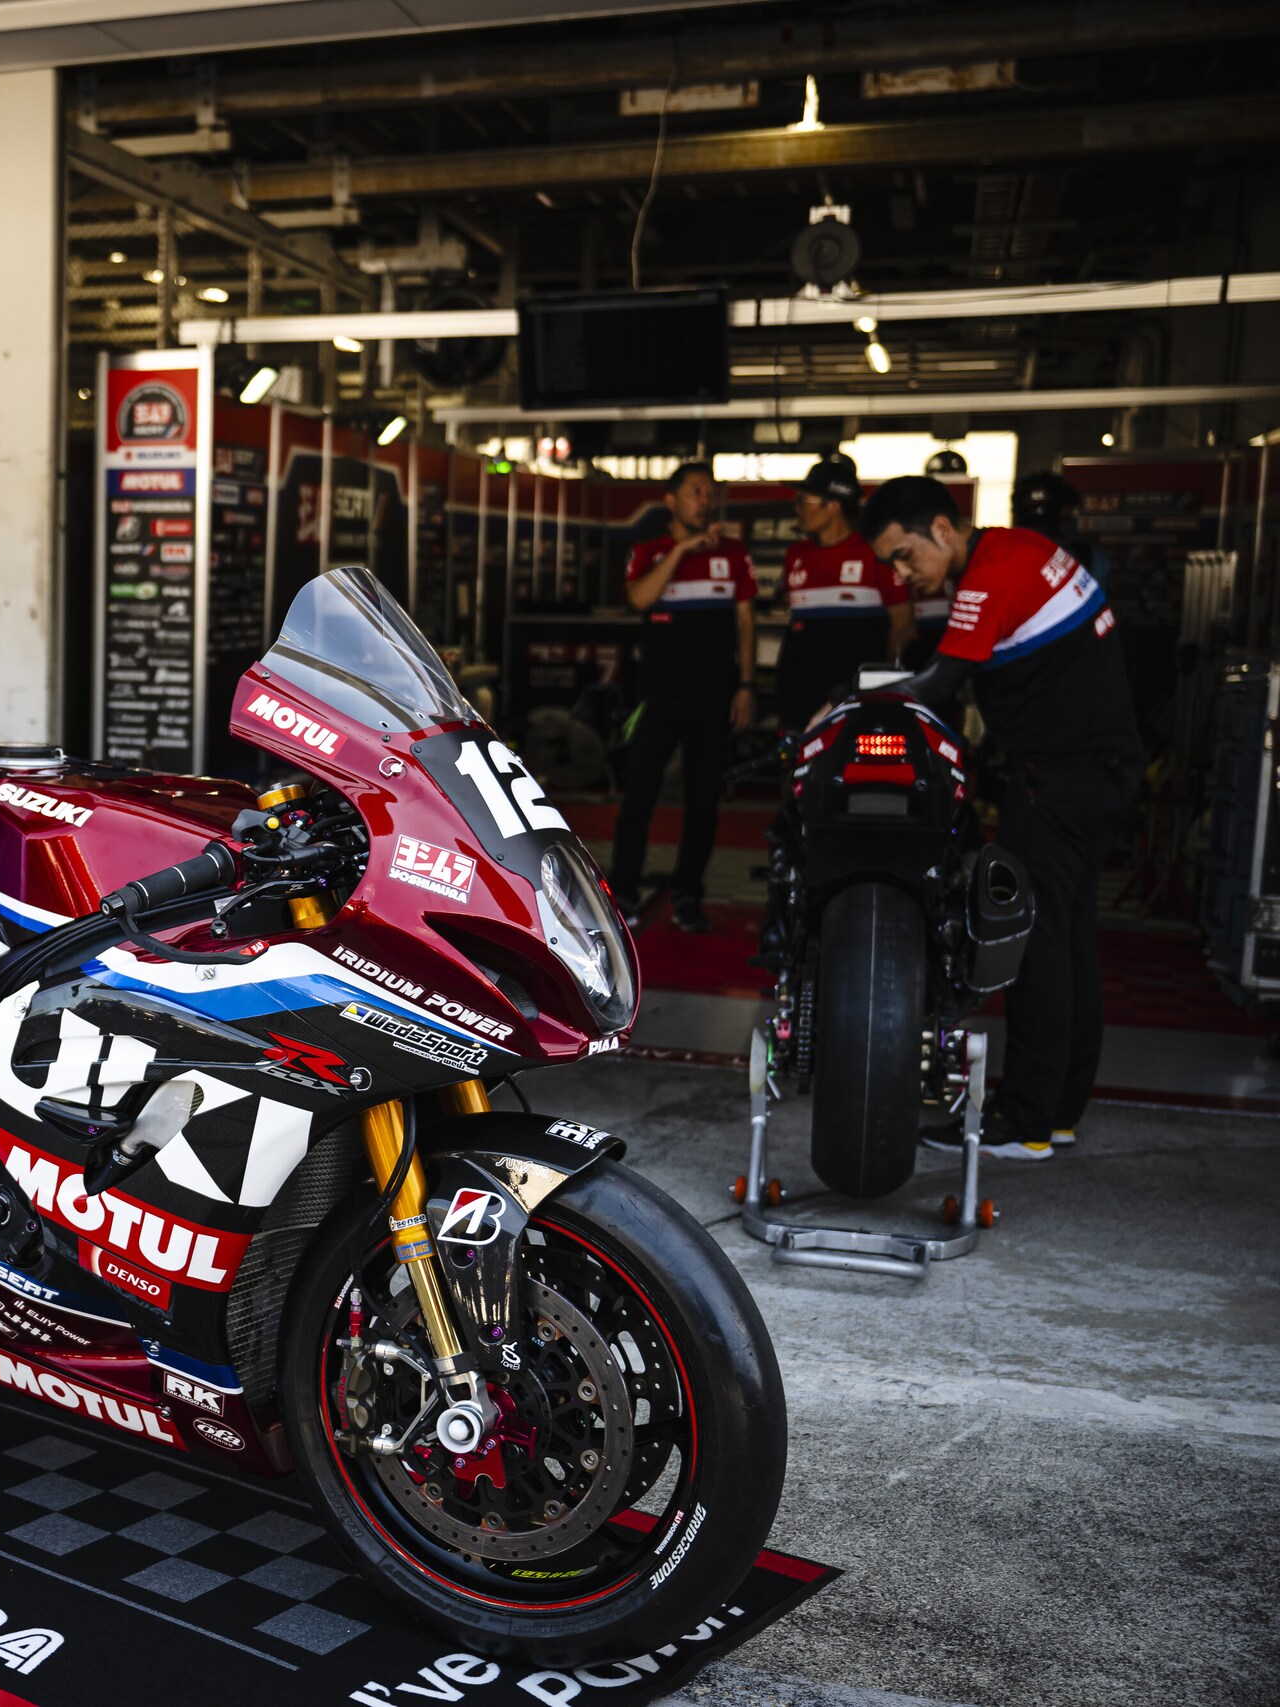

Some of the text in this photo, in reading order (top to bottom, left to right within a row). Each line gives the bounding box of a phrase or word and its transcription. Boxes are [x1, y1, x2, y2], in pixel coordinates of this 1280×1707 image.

[248, 694, 341, 757] MOTUL
[454, 740, 571, 839] 12
[389, 867, 468, 904] YOSHIMURA
[394, 837, 476, 891] ヨシムラ
[331, 944, 514, 1041] IRIDIUM POWER
[587, 1035, 619, 1056] PIAA
[5, 1145, 227, 1284] MOTUL
[106, 1262, 161, 1297] DENSO
[55, 1324, 91, 1346] Power
[166, 1374, 220, 1410] RK
[649, 1502, 707, 1589] BRIDGESTONE
